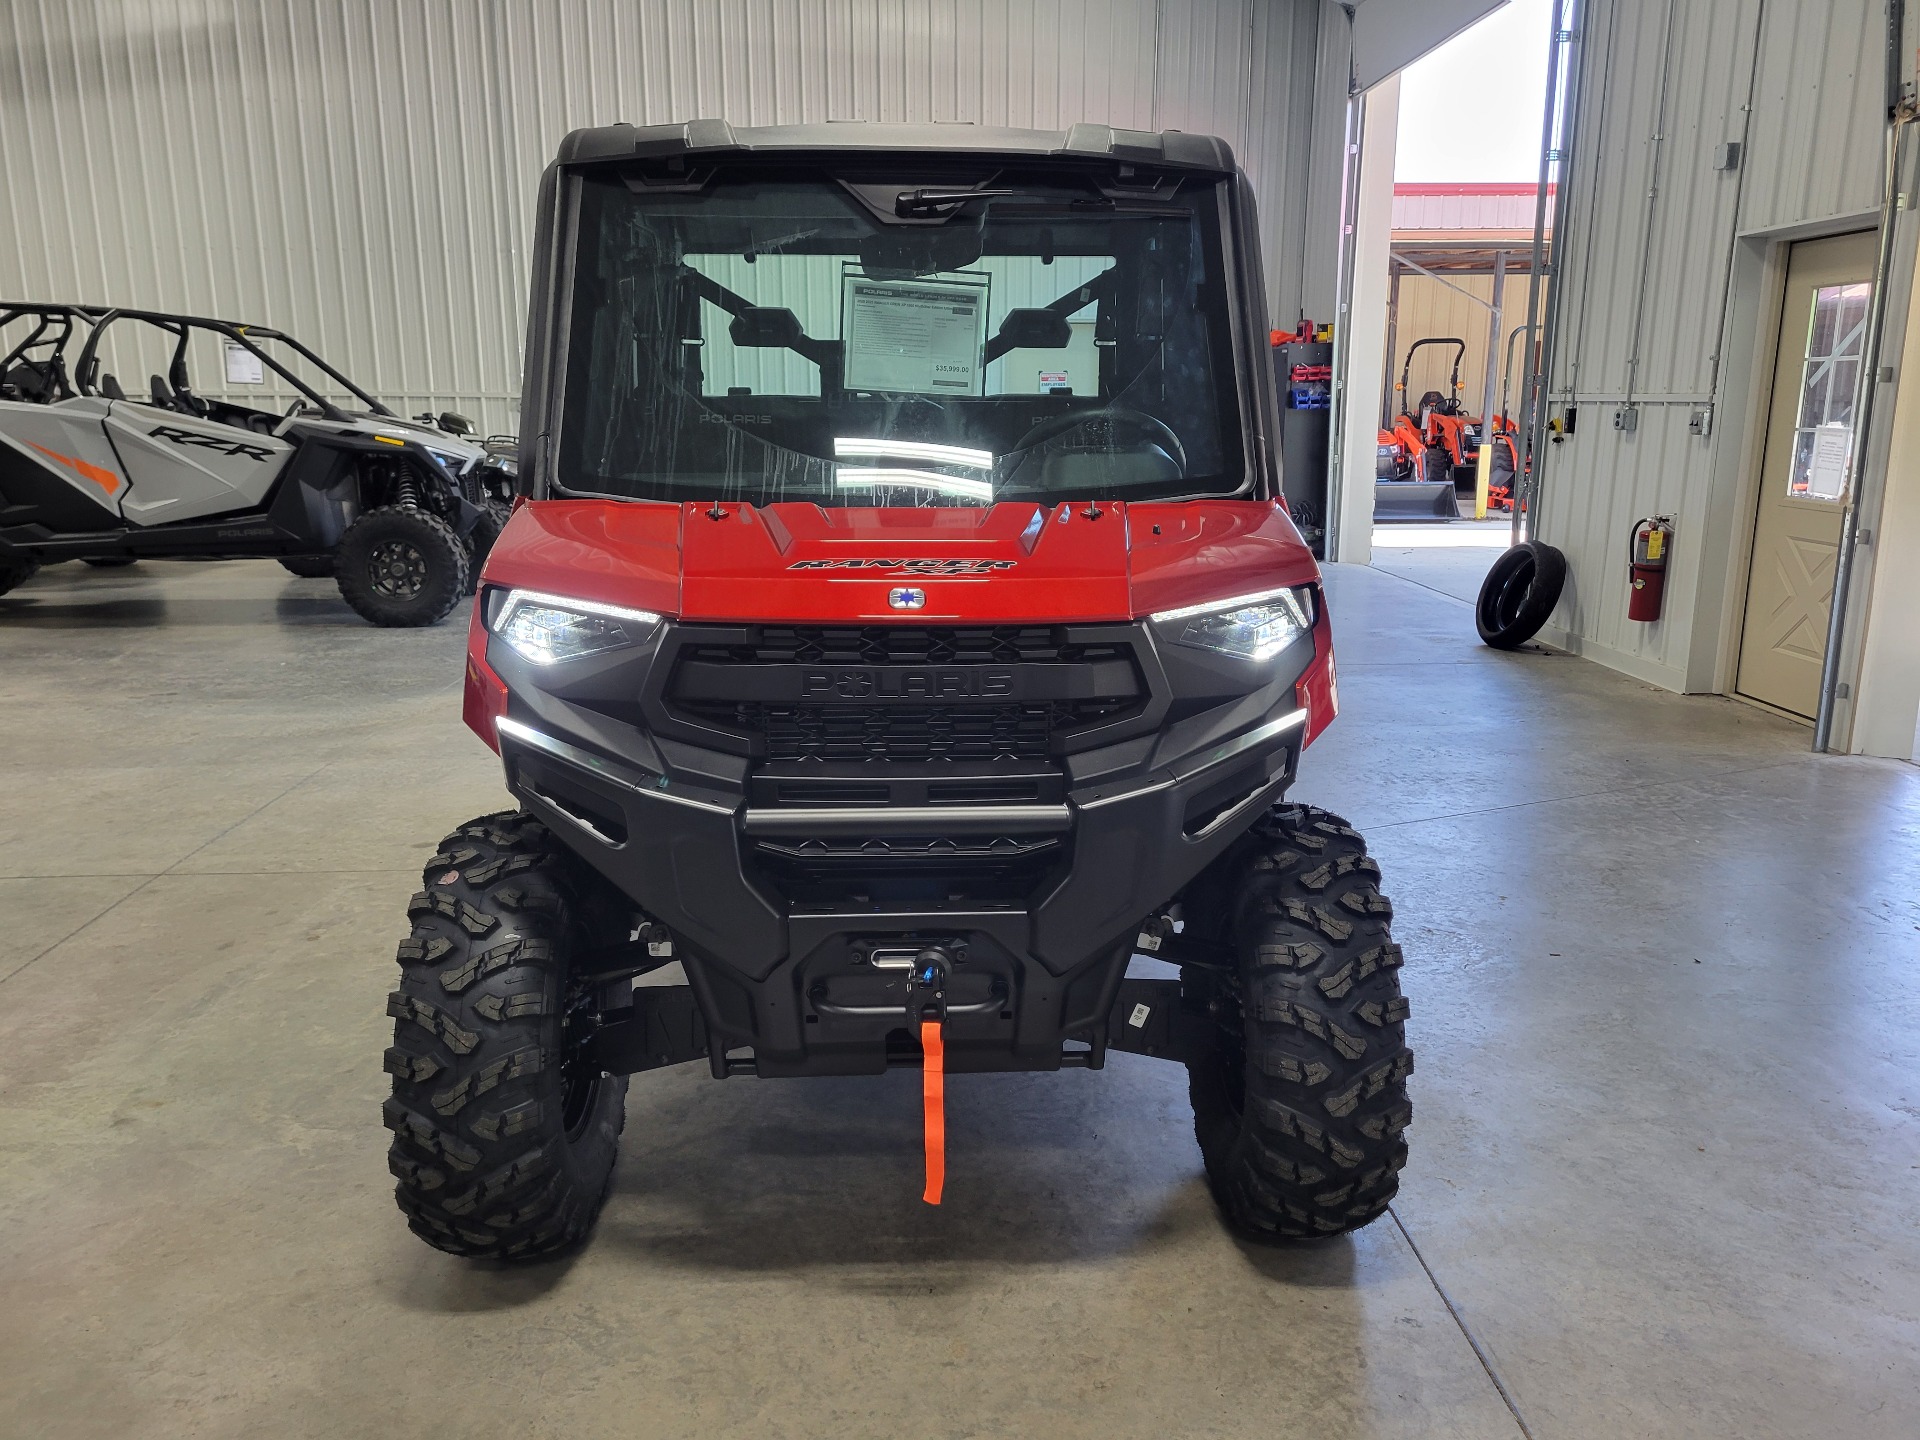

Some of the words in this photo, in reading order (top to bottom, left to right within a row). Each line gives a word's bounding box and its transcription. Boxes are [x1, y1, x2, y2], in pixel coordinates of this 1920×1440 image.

[863, 288, 893, 296] POLARIS
[699, 414, 772, 424] POLARIS
[147, 425, 277, 463] RZR
[218, 528, 275, 537] POLARIS
[786, 558, 1018, 570] RANGER
[885, 567, 991, 576] XP
[802, 670, 1015, 698] POLARIS
